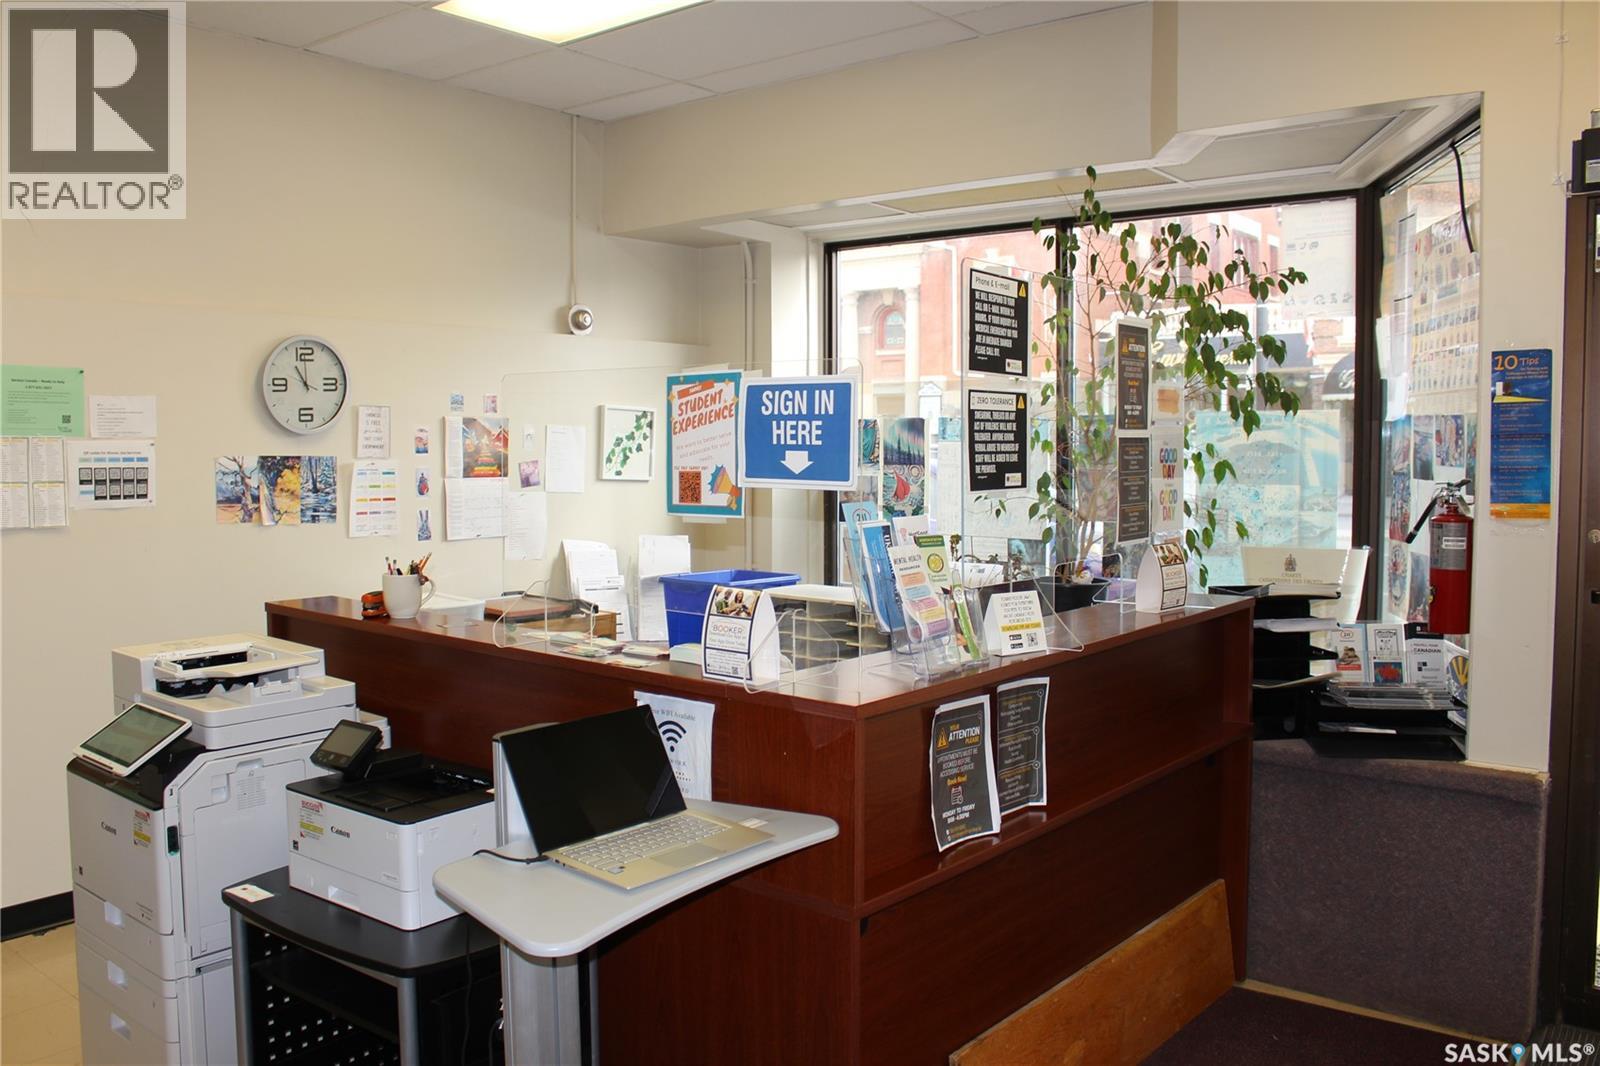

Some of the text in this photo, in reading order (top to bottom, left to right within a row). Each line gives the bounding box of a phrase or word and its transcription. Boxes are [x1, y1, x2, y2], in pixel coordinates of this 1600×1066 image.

[976, 276, 990, 286] Phone
[296, 347, 314, 362] 12
[1494, 354, 1540, 371] 10 Tips
[272, 378, 338, 392] 9 3
[677, 389, 724, 416] STUDENT
[761, 390, 834, 416] SIGN IN
[977, 396, 1014, 406] ZERO TOLERANCE
[298, 408, 314, 422] 6
[672, 402, 734, 436] EXPERIENCE
[772, 420, 822, 446] HERE
[1160, 448, 1178, 464] GOOD
[1162, 464, 1176, 478] DAY
[712, 624, 743, 634] BOOKER
[948, 726, 980, 742] ATTENTION
[330, 826, 350, 838] Canon
